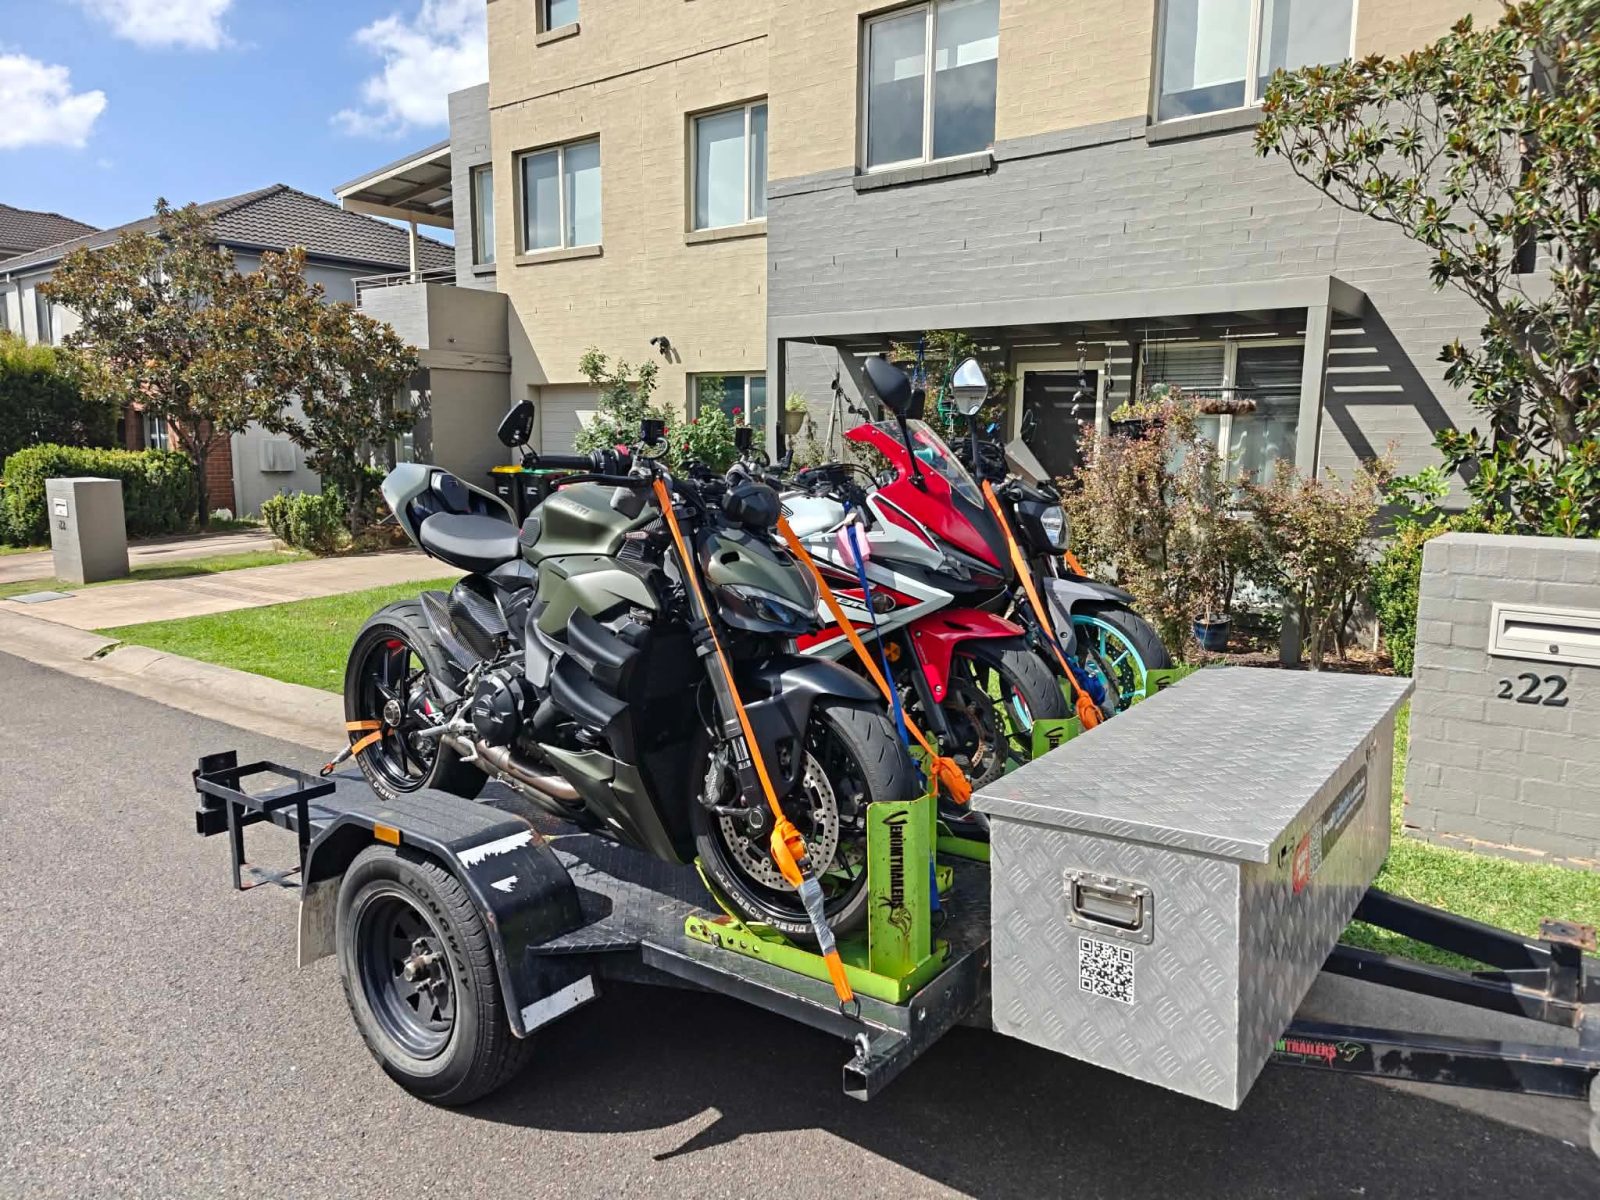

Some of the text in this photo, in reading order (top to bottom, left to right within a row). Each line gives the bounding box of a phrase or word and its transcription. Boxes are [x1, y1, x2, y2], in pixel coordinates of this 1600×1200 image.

[1497, 672, 1569, 707] 222
[882, 810, 909, 910] VENOMTRAILERS
[731, 891, 764, 920] ROSSO
[407, 878, 471, 992] LONGWAY
[765, 917, 808, 934] DIABLO
[1274, 1038, 1338, 1058] MTRAILERS
